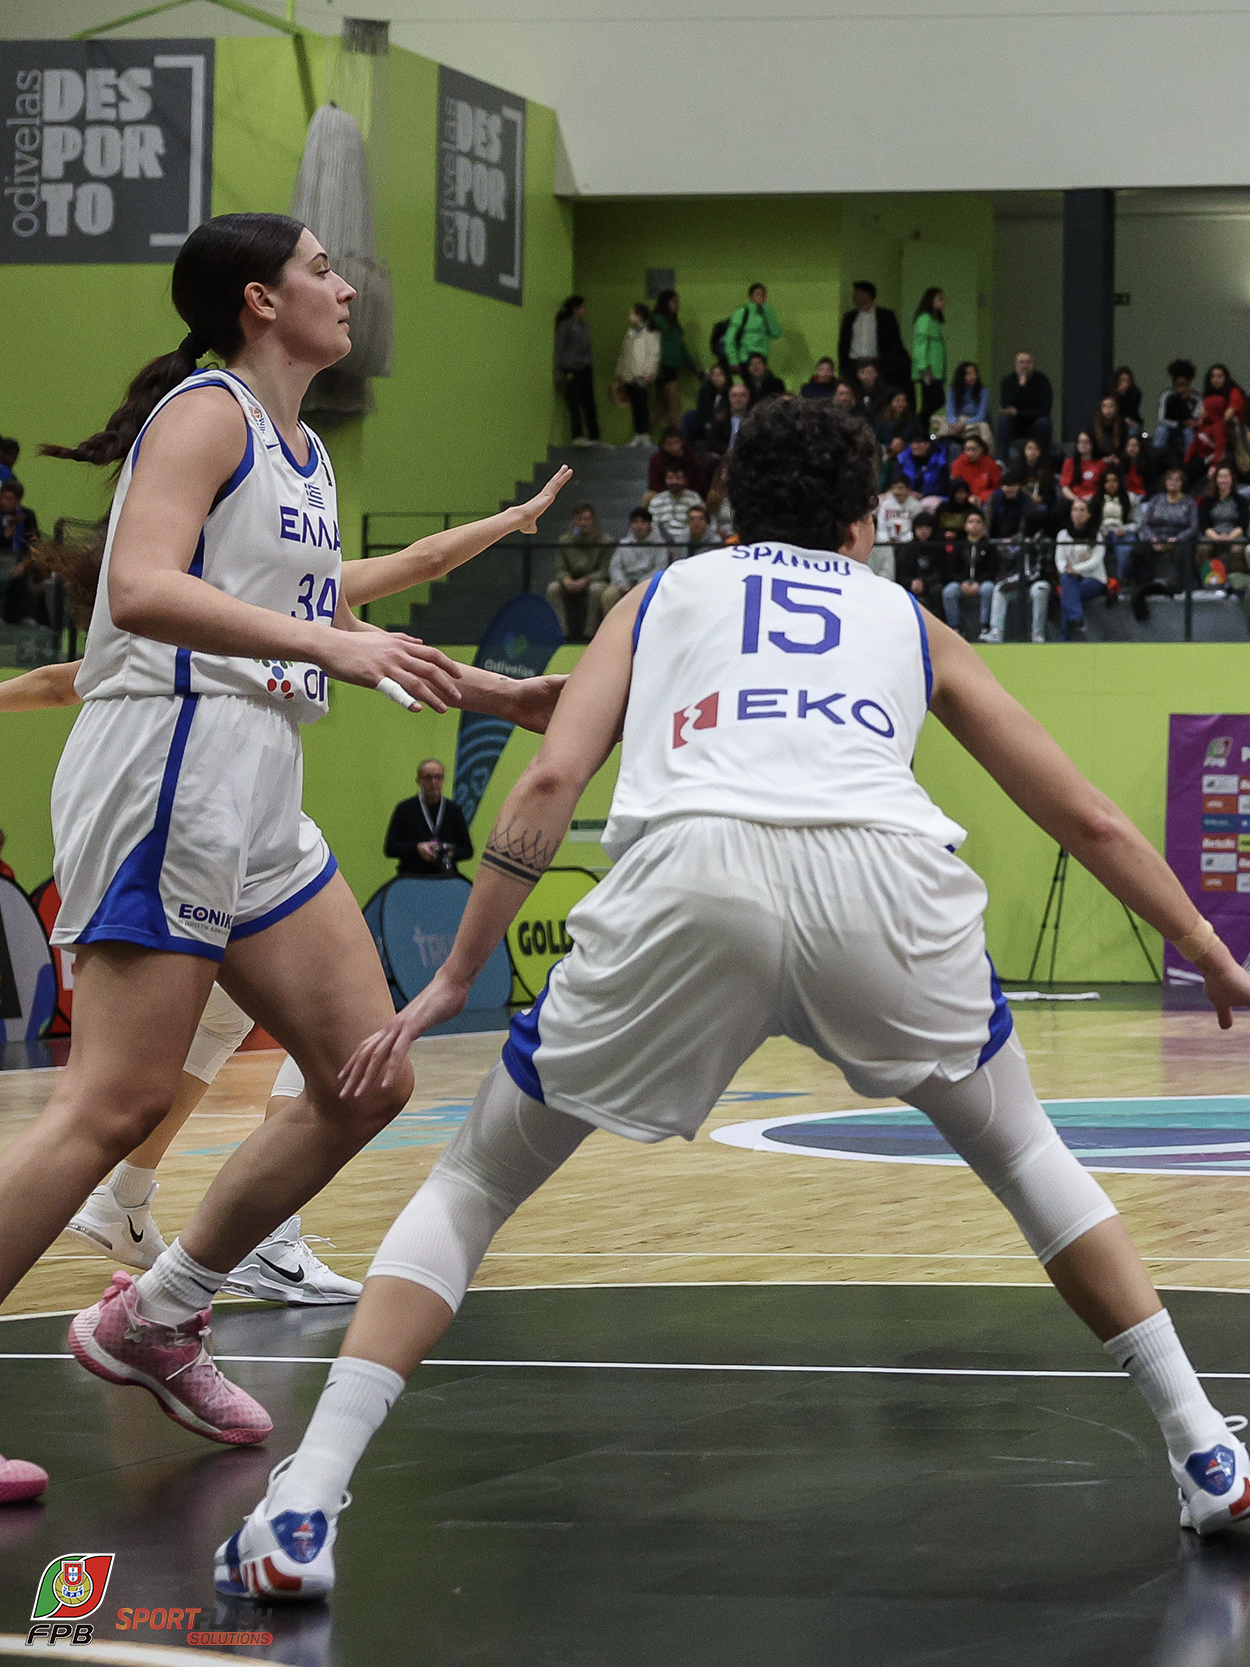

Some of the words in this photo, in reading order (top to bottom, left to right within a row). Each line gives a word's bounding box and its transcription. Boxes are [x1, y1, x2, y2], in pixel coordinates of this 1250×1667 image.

[43, 67, 153, 122] DES
[4, 68, 42, 237] odivelas
[41, 124, 165, 179] POR
[40, 182, 114, 236] TO
[290, 573, 338, 622] 34
[740, 574, 842, 655] 15
[737, 688, 895, 739] EKO
